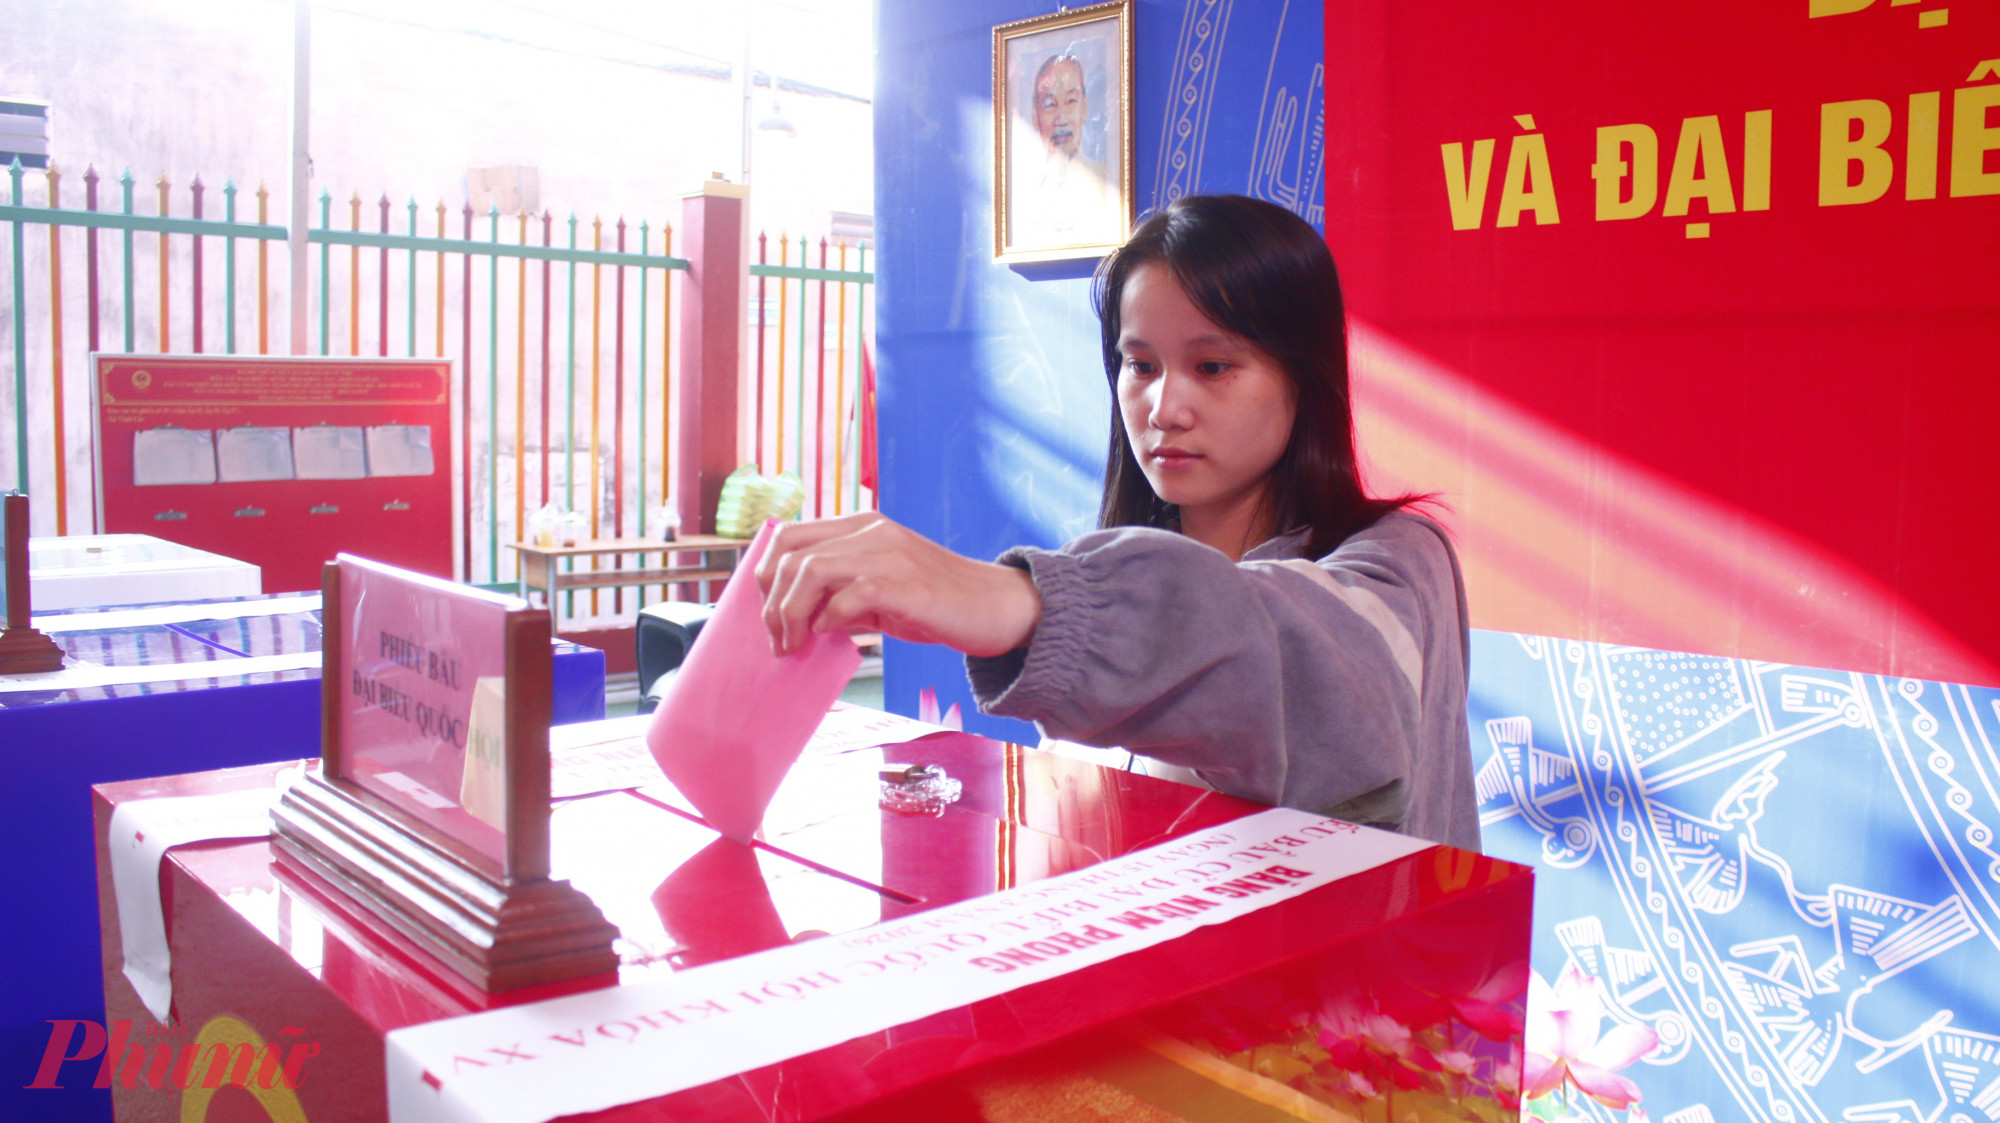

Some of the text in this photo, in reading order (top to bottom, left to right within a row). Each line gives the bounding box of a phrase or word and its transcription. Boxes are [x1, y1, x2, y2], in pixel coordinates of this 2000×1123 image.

[1440, 113, 1560, 231] VÀ
[1591, 109, 1772, 239] ĐẠI
[967, 924, 1124, 974] PHONG
